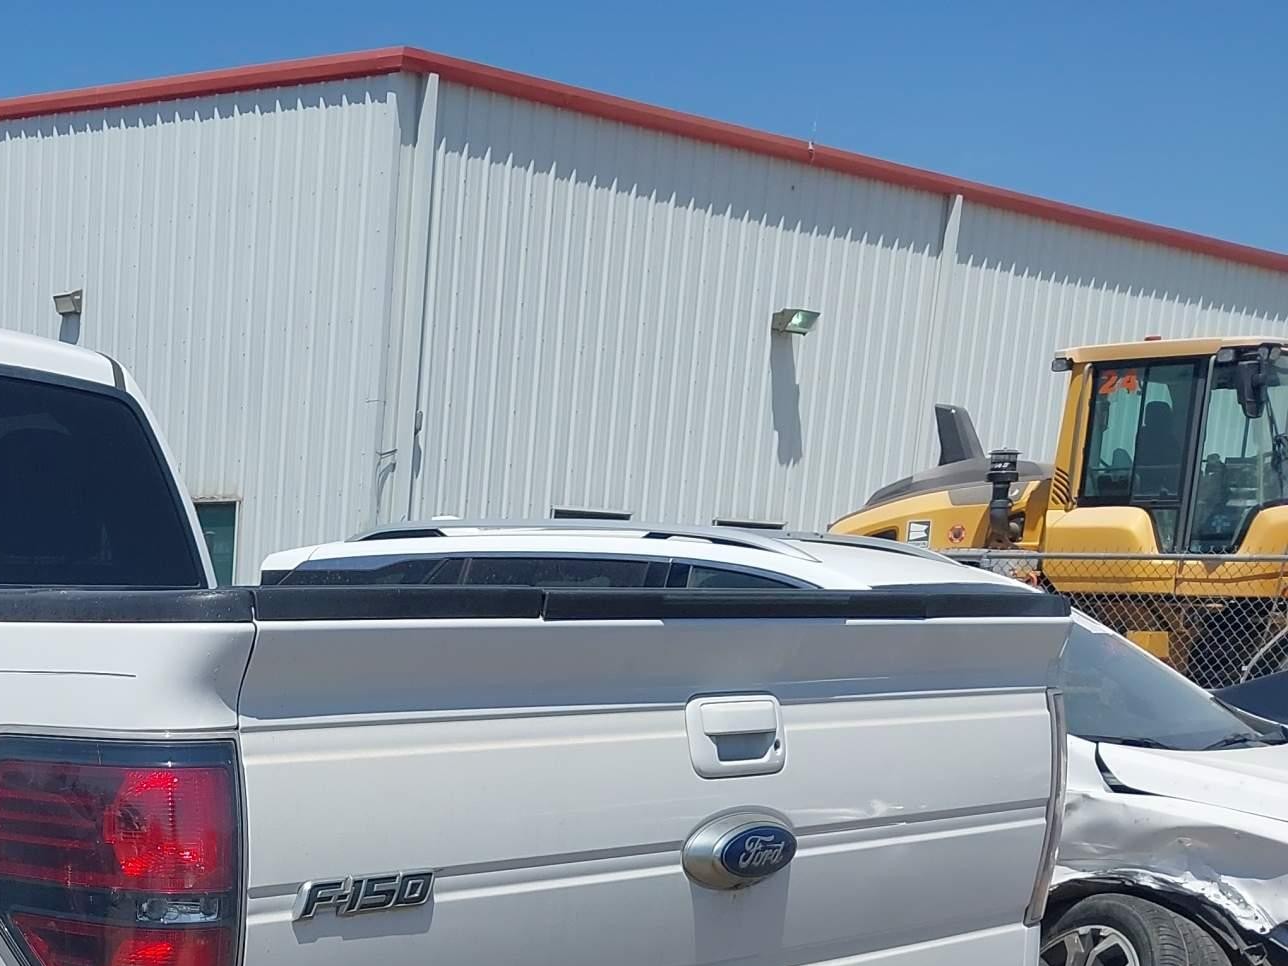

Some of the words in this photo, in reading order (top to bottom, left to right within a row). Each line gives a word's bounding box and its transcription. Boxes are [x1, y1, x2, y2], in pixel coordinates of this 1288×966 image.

[1098, 369, 1138, 394] 24
[739, 834, 785, 868] Ford
[296, 872, 435, 918] F-150
